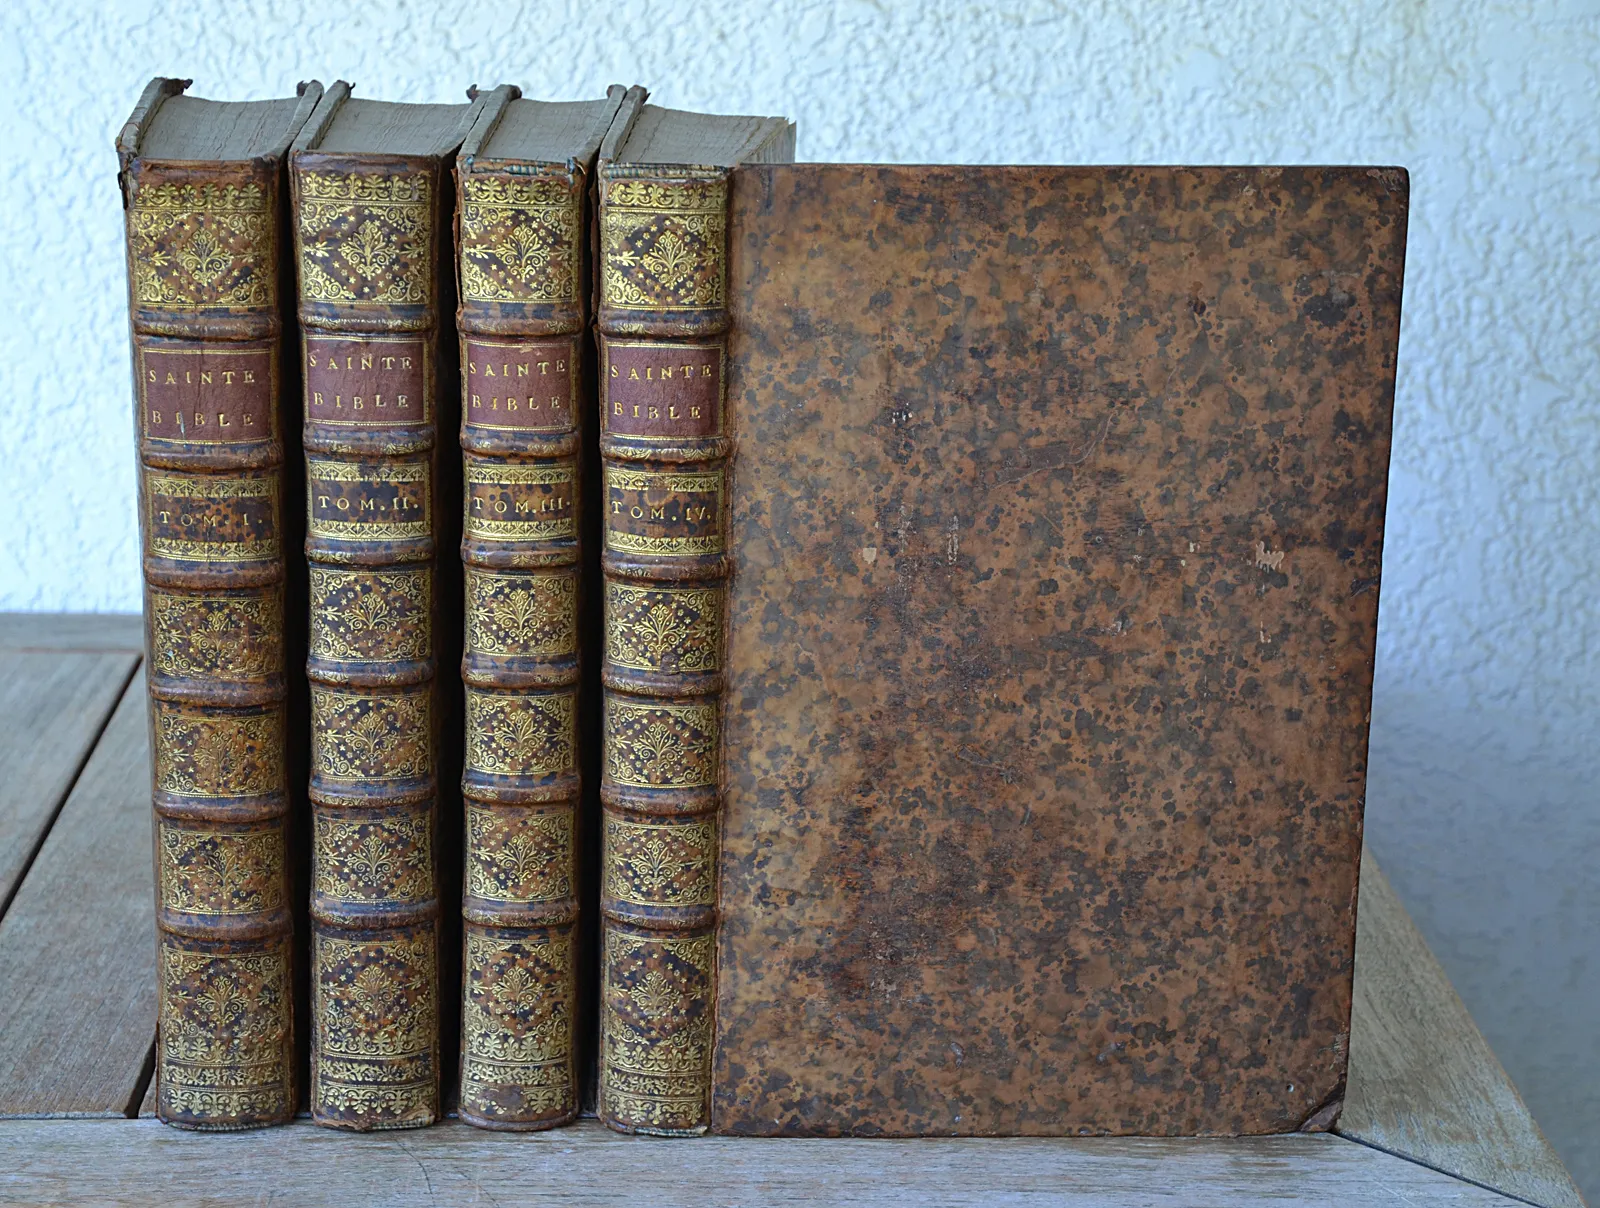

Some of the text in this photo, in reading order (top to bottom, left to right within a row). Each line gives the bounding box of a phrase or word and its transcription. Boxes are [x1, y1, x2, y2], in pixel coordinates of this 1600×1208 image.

[309, 355, 412, 370] SAINTE
[469, 359, 566, 377] SAINTE
[149, 369, 255, 385] SAINTE
[611, 364, 712, 380] SAINTE
[314, 392, 409, 409] BIBLE
[472, 394, 561, 411] BIBLE
[152, 410, 253, 427] BIBLE
[614, 401, 701, 419] BIBLE
